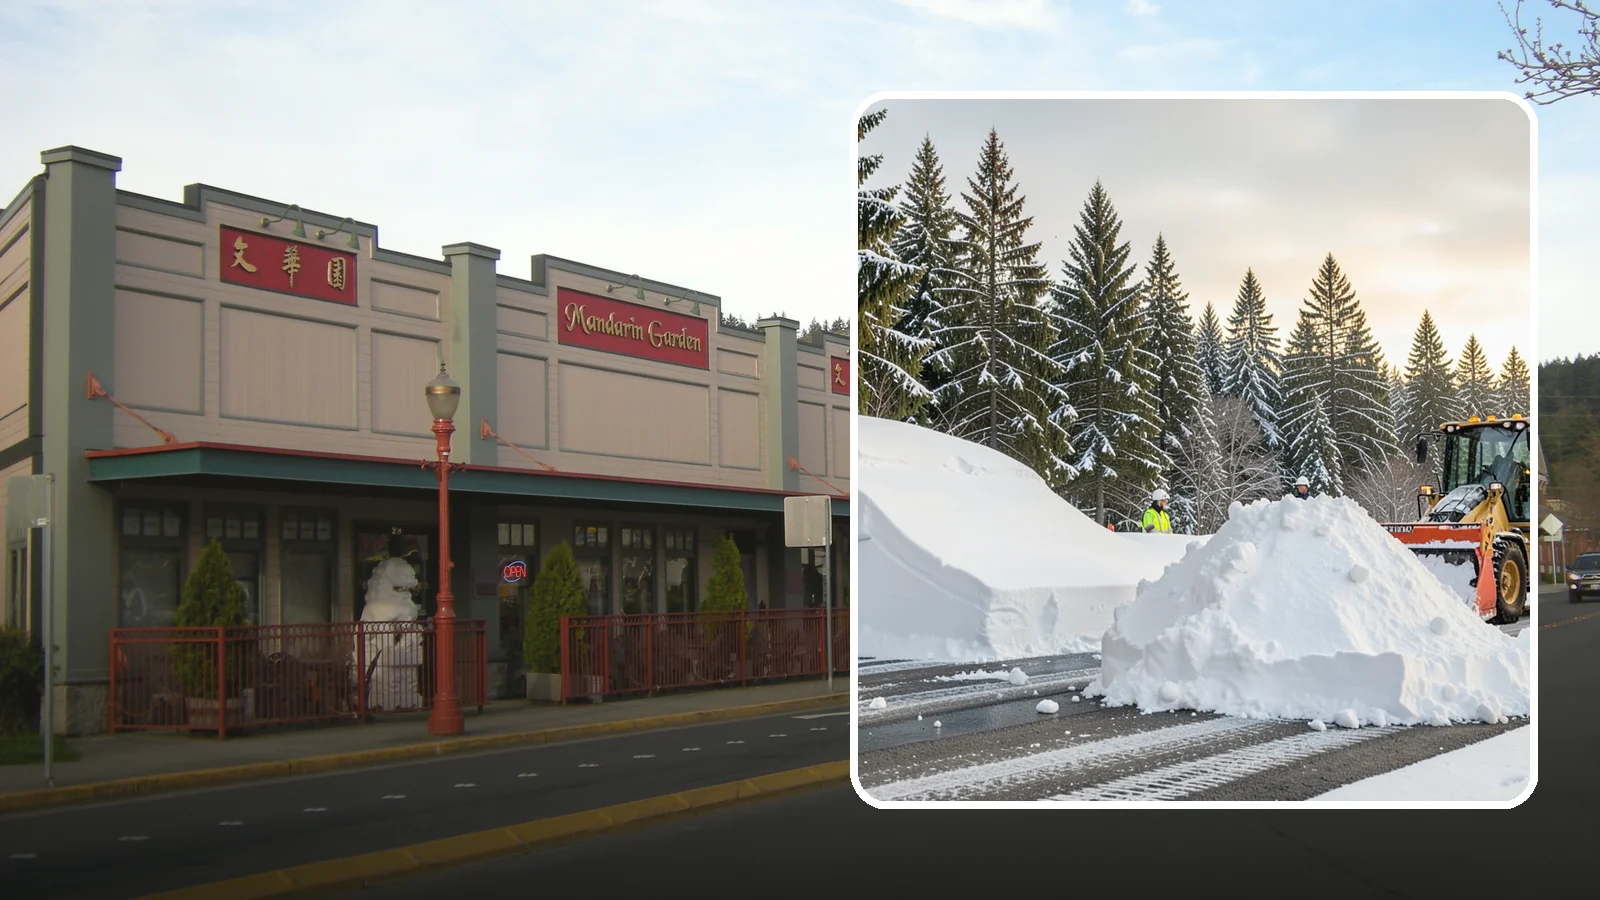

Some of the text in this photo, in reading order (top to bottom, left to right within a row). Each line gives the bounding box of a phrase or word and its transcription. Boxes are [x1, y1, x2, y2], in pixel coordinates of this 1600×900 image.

[230, 235, 346, 291] 文華園
[564, 302, 701, 352] Mandarin Garden
[503, 565, 527, 578] OPEN
